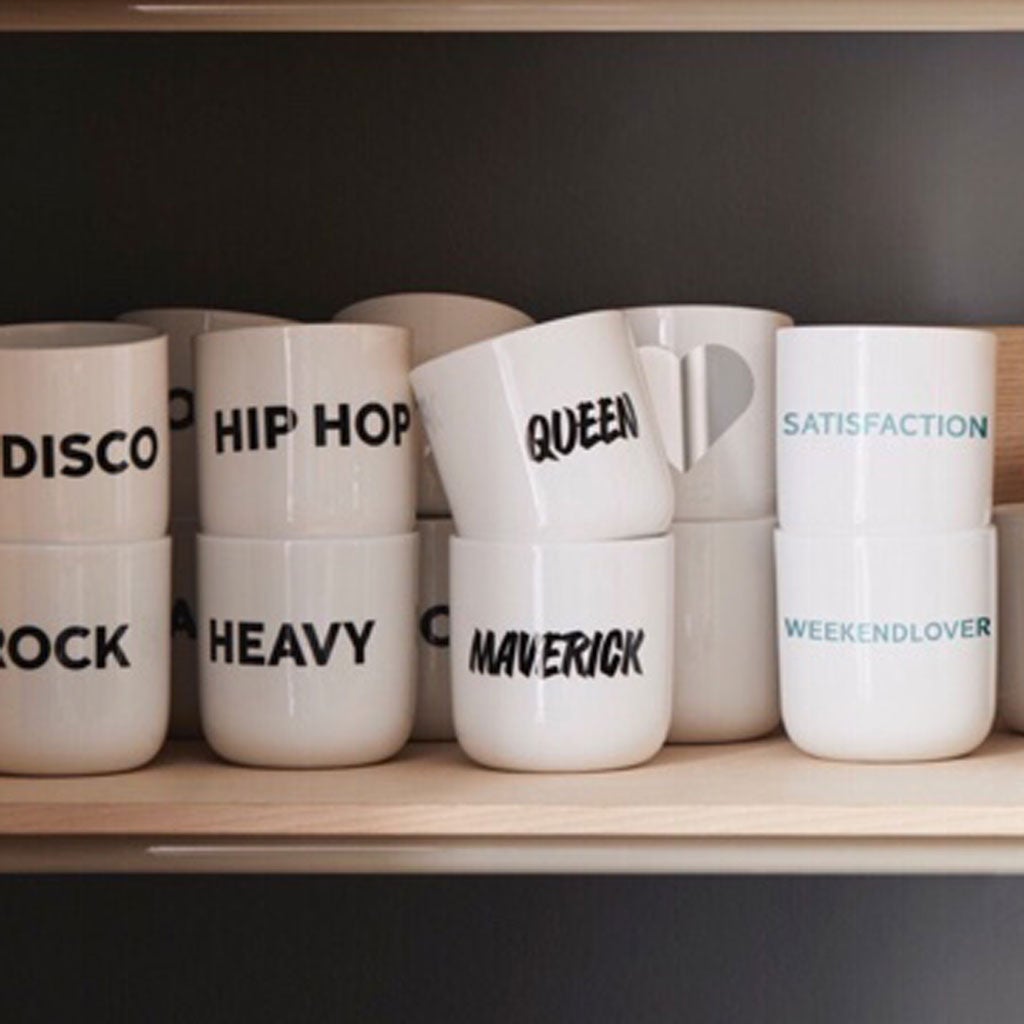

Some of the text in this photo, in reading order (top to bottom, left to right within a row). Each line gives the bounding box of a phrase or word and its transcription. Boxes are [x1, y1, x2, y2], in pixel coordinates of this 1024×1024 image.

[215, 405, 298, 454] HIP
[314, 402, 411, 447] HOP
[526, 392, 638, 463] QUEEN
[783, 412, 988, 440] SATISFACTION
[2, 426, 158, 478] DISCO
[0, 624, 131, 671] OCK
[209, 620, 376, 666] HEAVY
[468, 628, 645, 680] MAVERICK
[784, 616, 991, 644] WEEKENDLOVER
